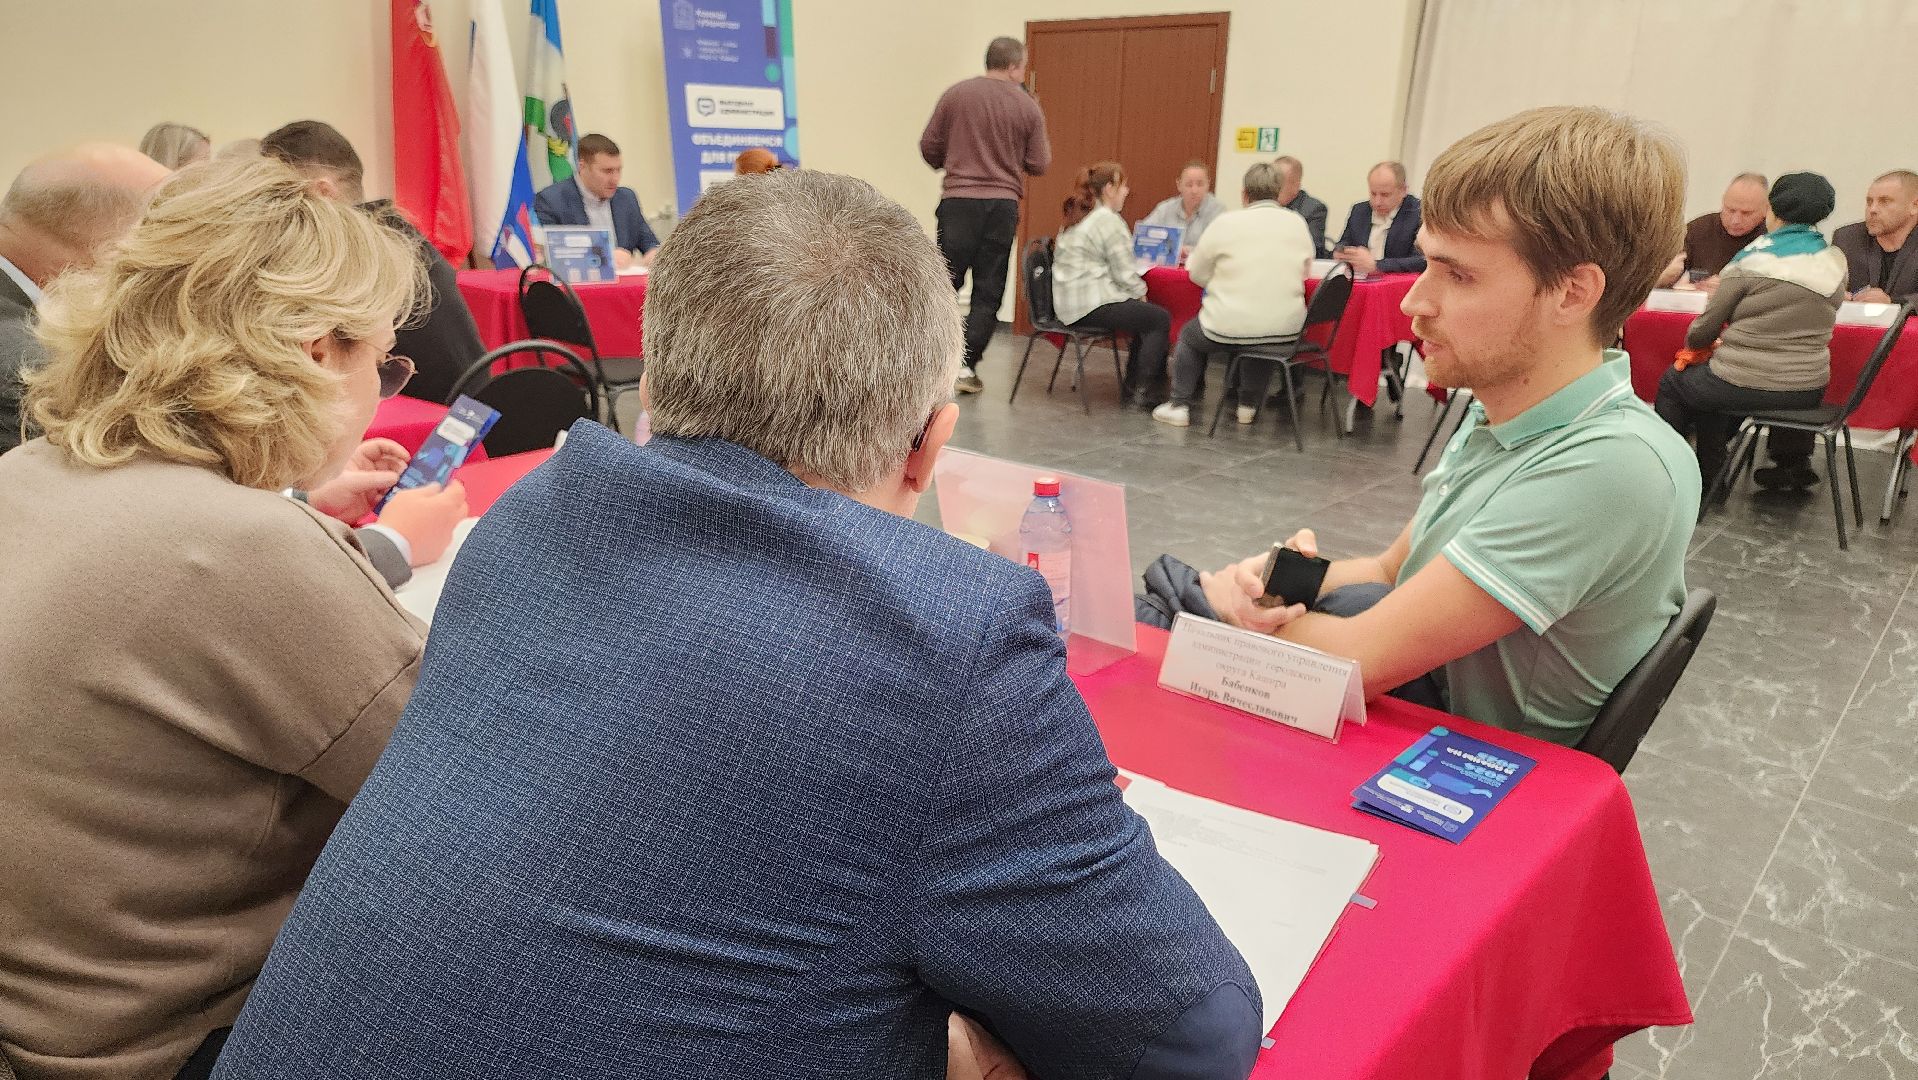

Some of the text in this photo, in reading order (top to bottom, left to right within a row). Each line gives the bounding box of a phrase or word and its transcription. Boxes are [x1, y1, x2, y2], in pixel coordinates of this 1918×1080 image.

[1287, 650, 1348, 677] управления
[1190, 681, 1298, 723] Игорь Вячеславович
